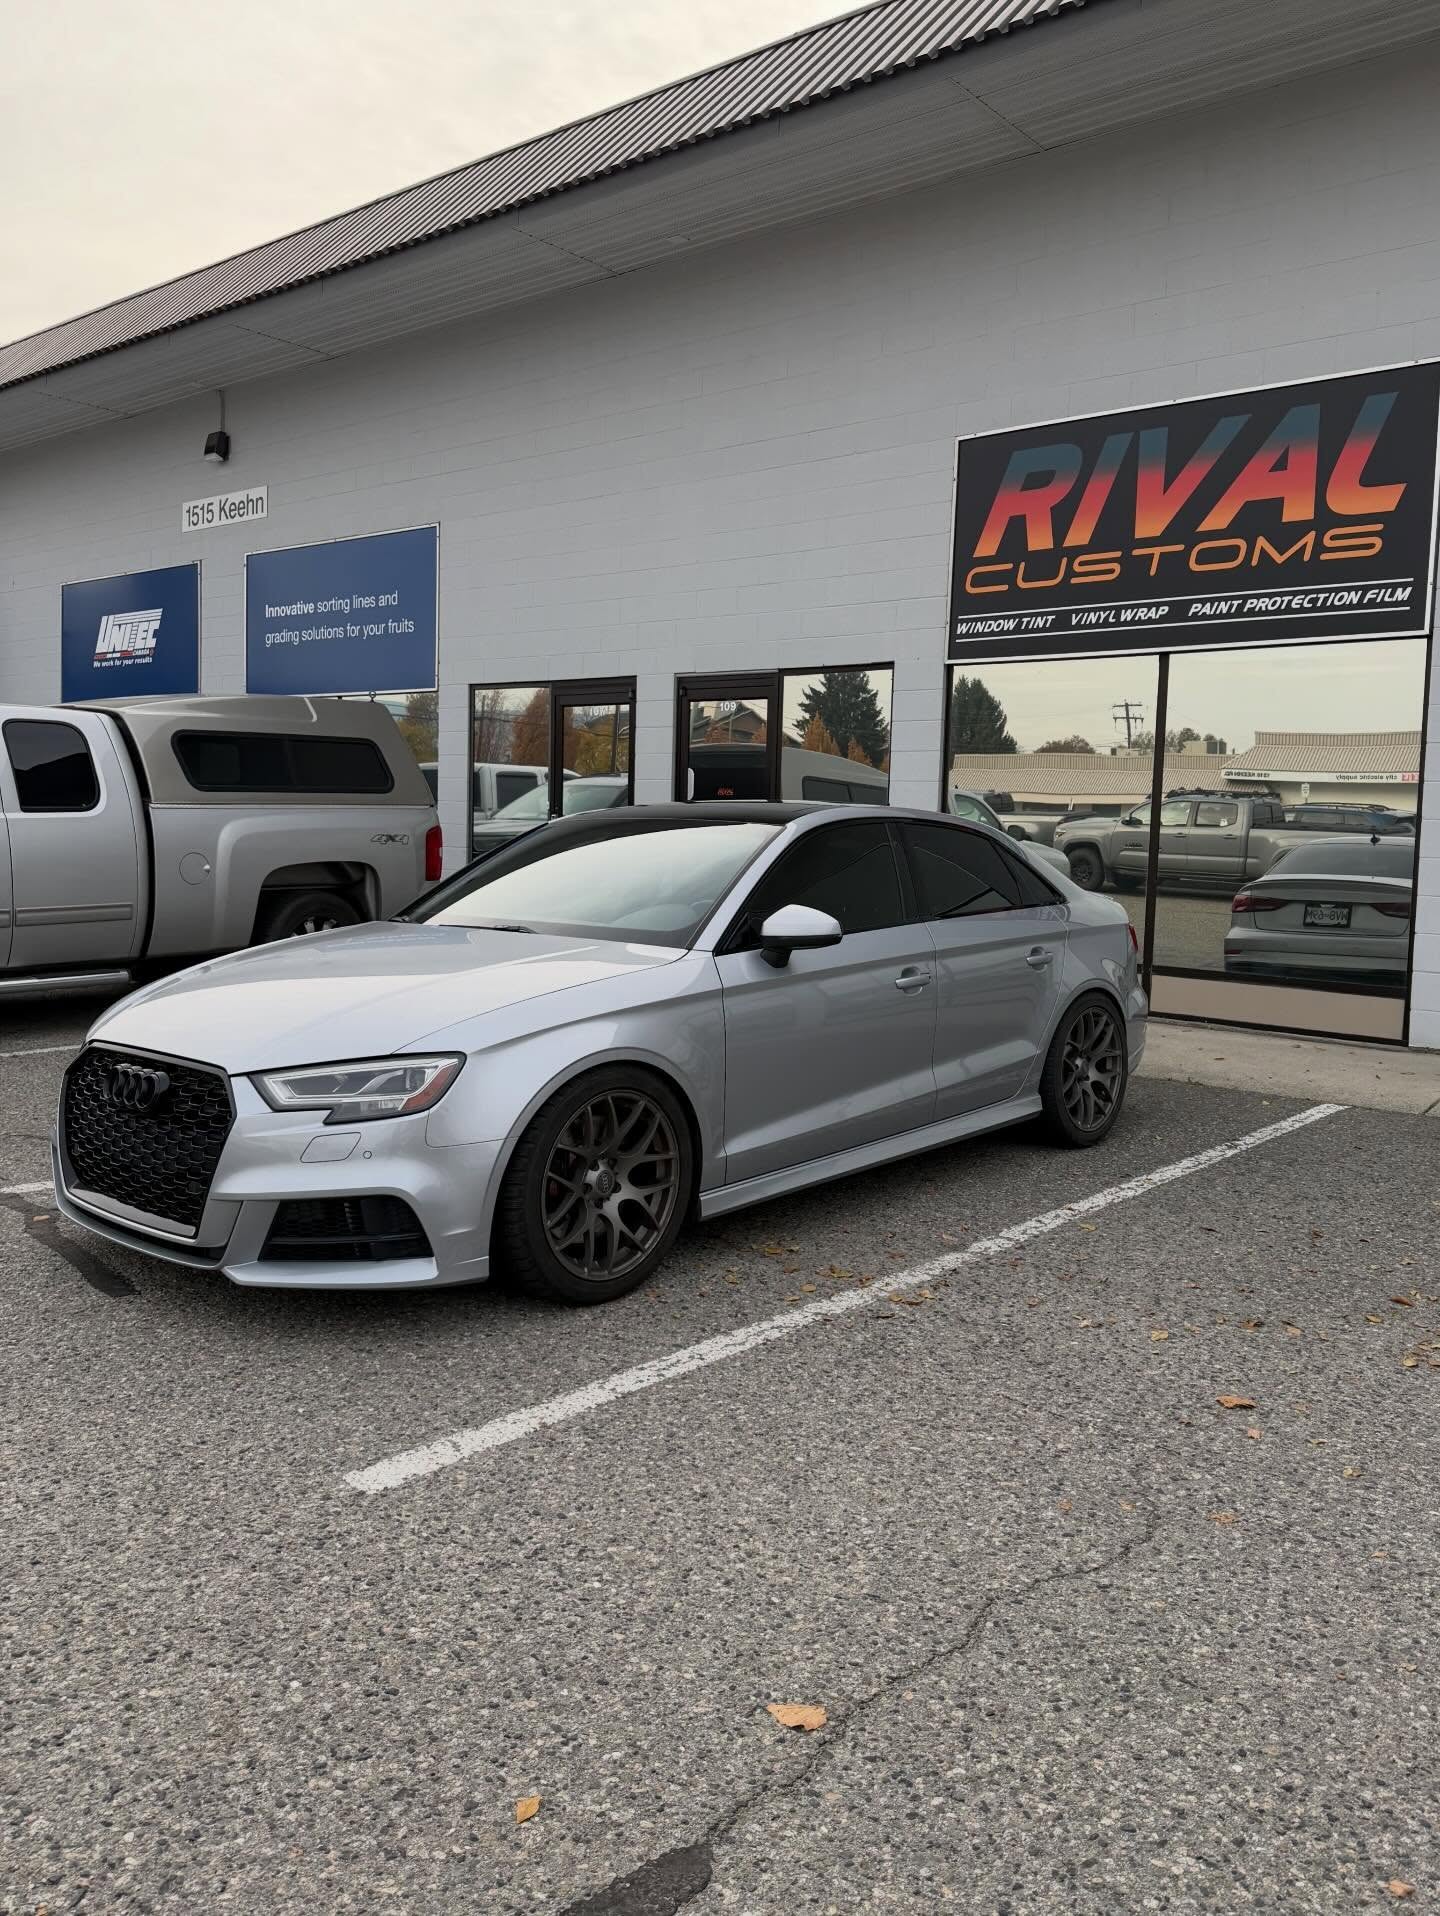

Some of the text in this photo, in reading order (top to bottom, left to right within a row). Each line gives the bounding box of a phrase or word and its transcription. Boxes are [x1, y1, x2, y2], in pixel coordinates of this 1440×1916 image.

[972, 391, 1408, 558] RIVAL
[186, 493, 264, 527] 1515 Keehn
[965, 524, 1383, 594] CUSTOMS
[265, 590, 398, 618] Innovative sorting lines and
[956, 586, 1412, 634] WINDOW TINT VINYL WRAP PAINT PROTECTION FILM
[96, 608, 163, 653] UNITEC
[265, 618, 414, 648] grading solutions for your fruits
[93, 660, 100, 668] We
[114, 658, 122, 666] for
[122, 658, 134, 667] your
[134, 656, 152, 664] results
[720, 701, 737, 711] 109
